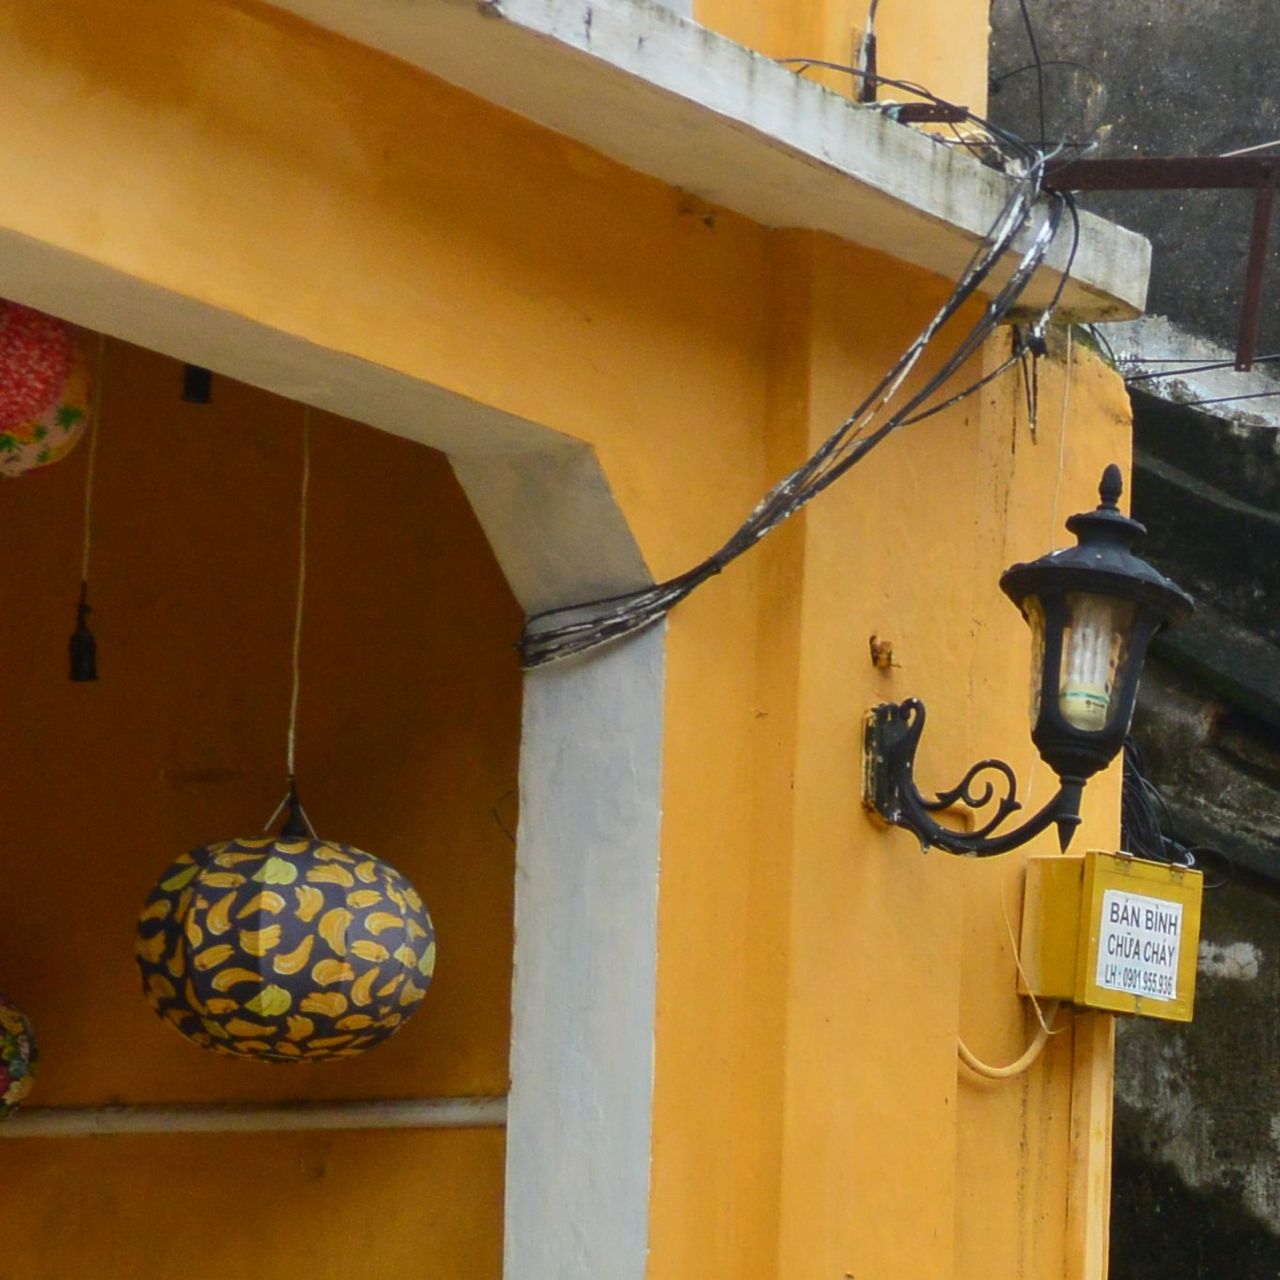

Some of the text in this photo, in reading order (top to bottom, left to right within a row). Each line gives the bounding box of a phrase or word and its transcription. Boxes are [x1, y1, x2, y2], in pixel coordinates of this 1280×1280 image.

[1110, 898, 1178, 936] BÁN BÌNH
[1107, 931, 1175, 968] CHỮA CHÁY
